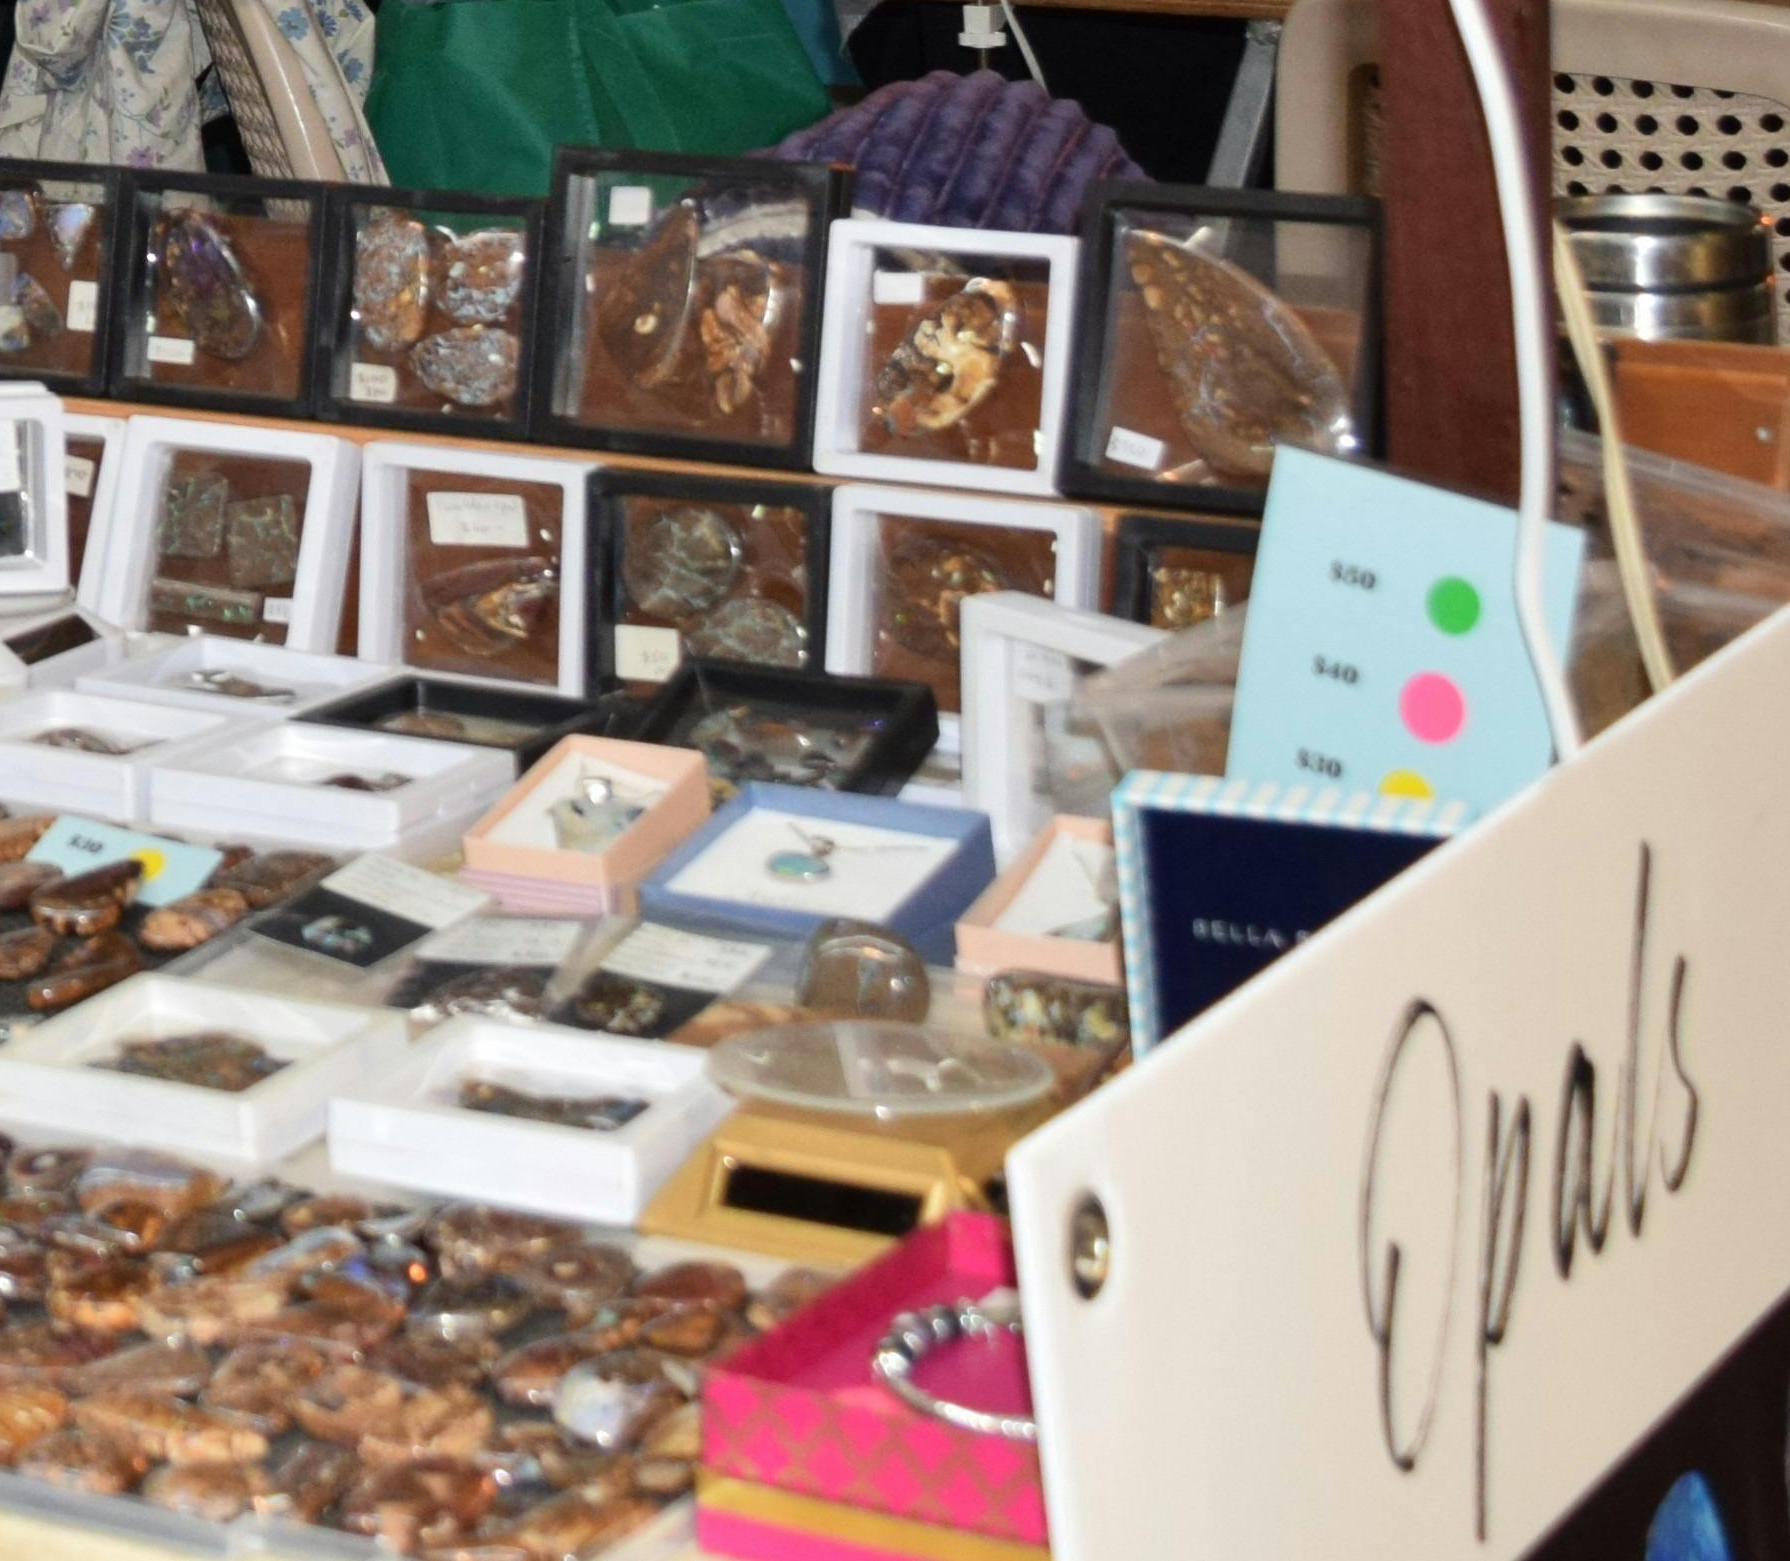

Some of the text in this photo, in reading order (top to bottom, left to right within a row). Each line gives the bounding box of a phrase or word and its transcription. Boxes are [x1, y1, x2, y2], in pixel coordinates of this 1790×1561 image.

[1330, 558, 1377, 590] $50
[1312, 655, 1361, 685] $40
[1295, 746, 1343, 779] $30
[1191, 917, 1286, 950] BELLA
[1359, 839, 1699, 1543] Opals
